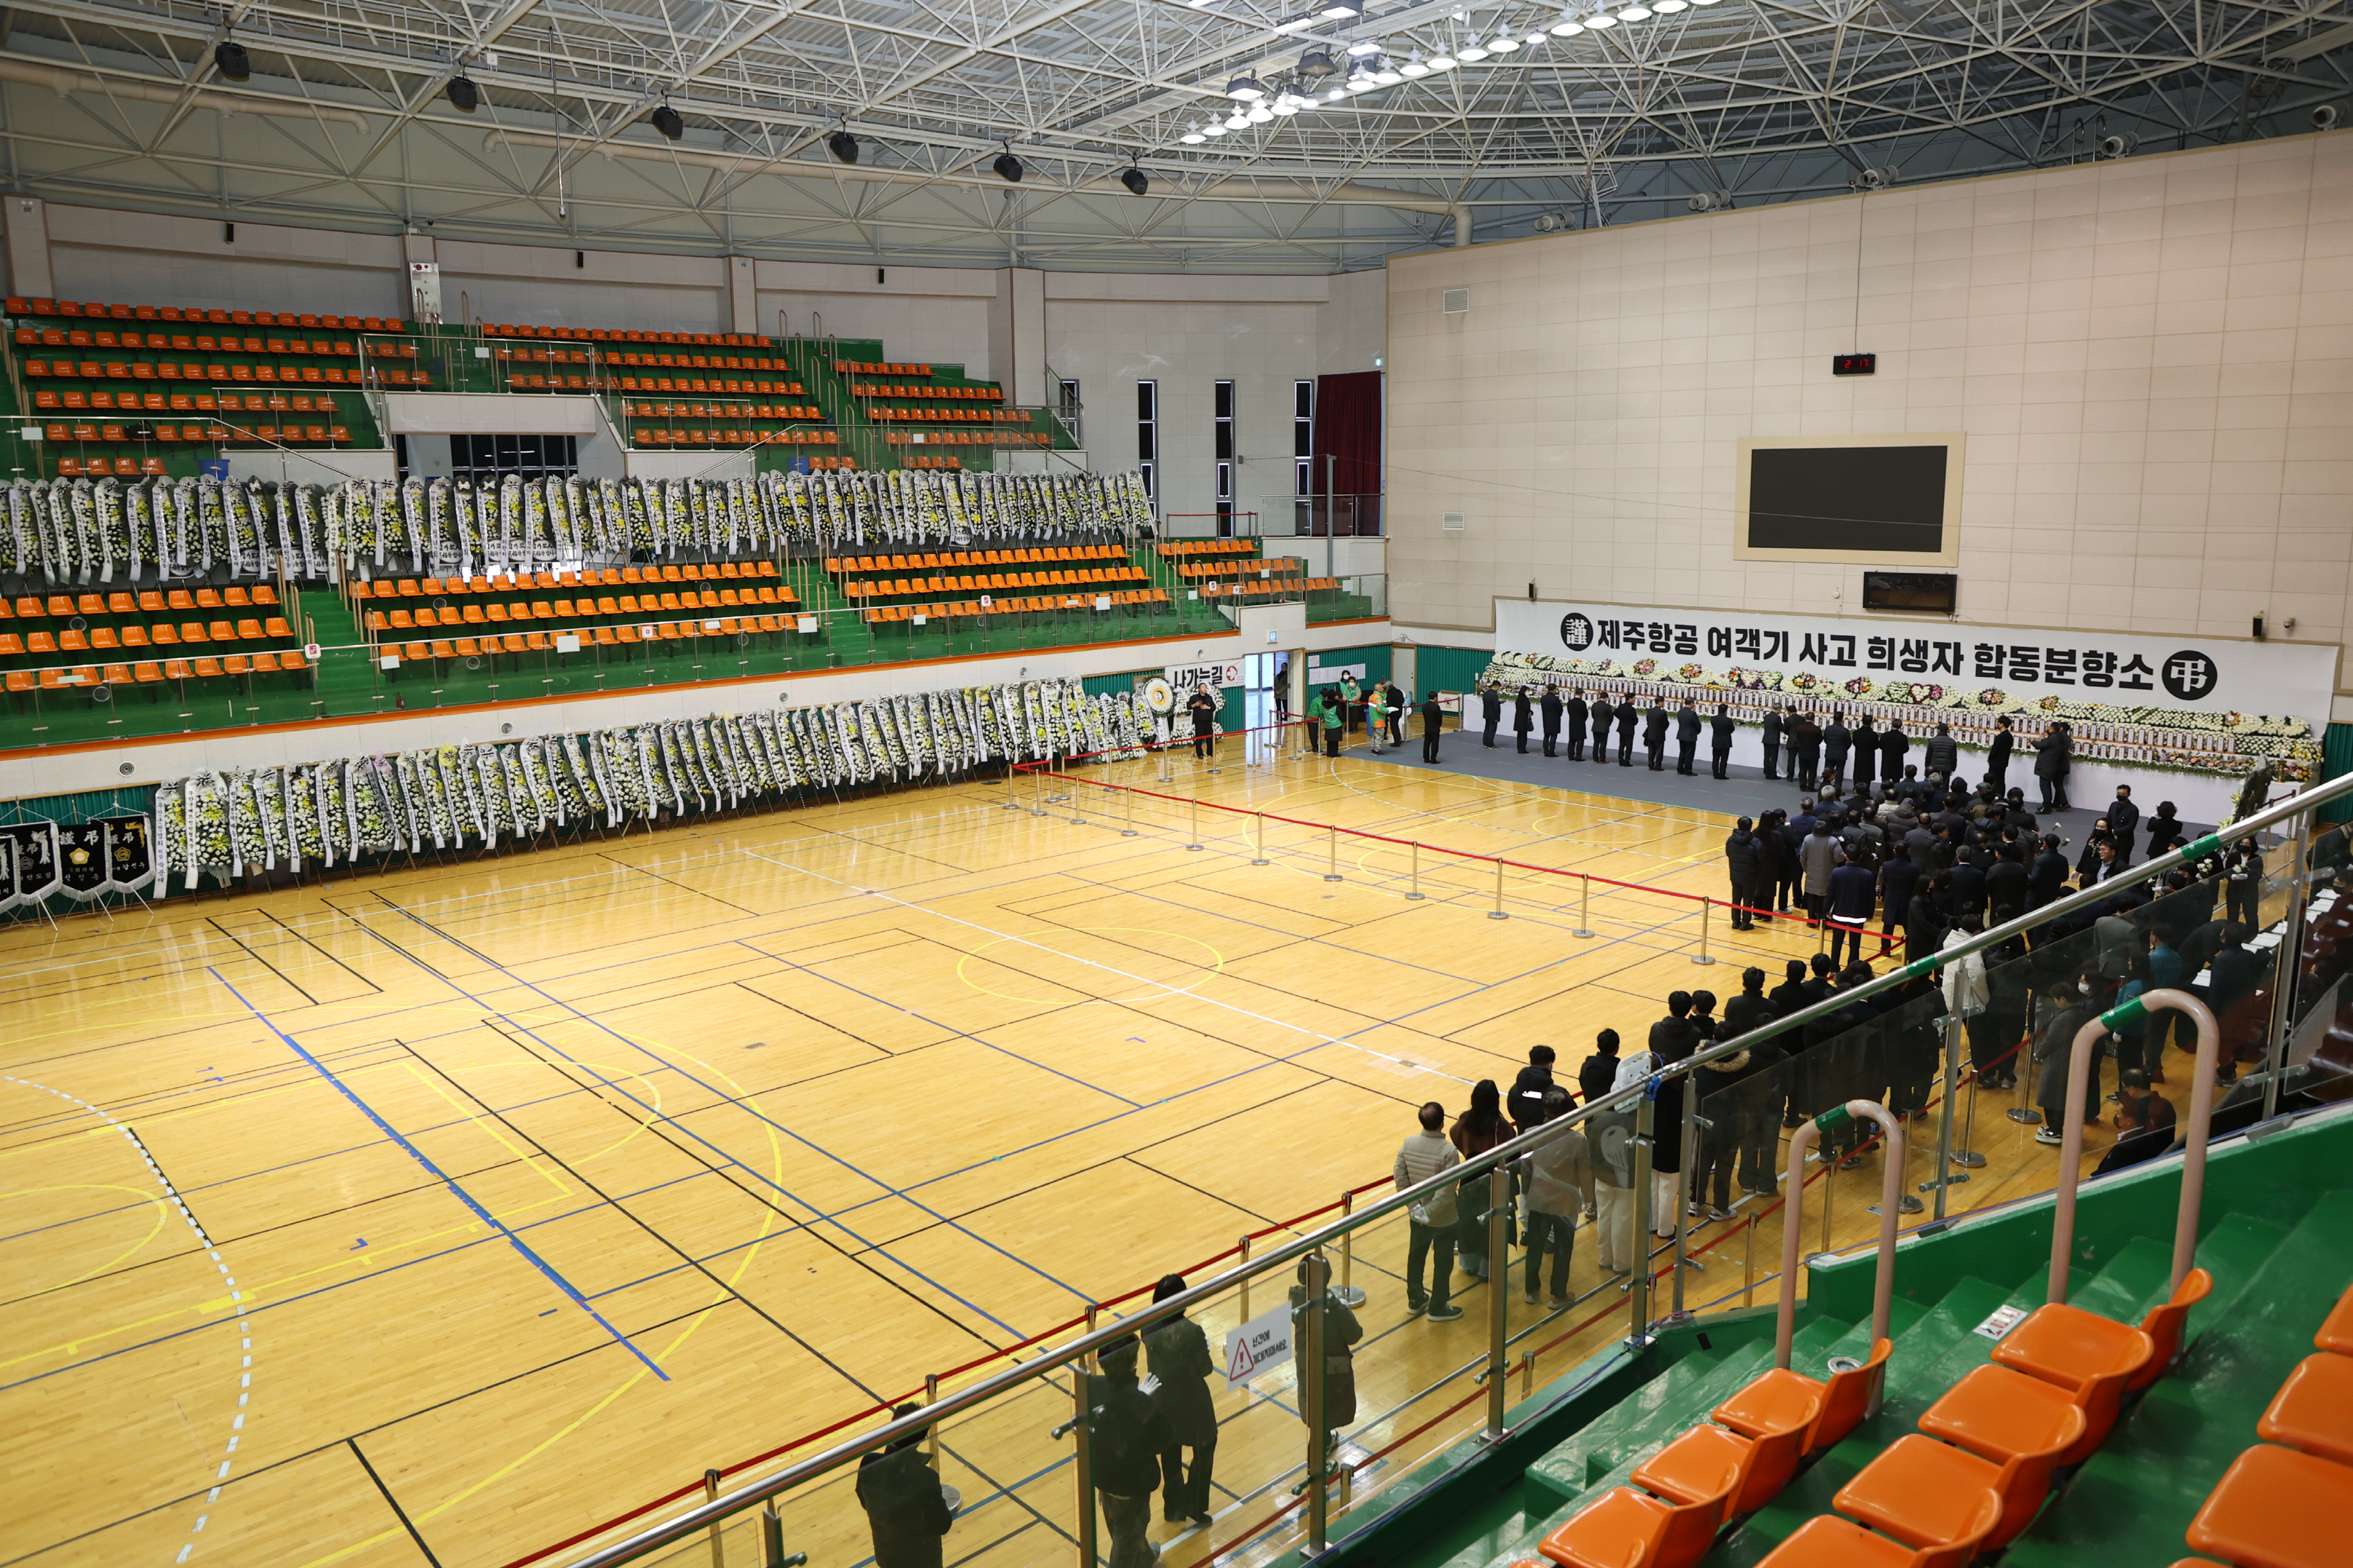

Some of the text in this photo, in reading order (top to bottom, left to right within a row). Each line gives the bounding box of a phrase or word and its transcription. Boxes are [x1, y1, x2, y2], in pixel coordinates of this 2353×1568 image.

[1598, 619, 2154, 691] 제주항공 여객기 사고 희생자 합동분향소
[1175, 665, 1222, 689] 나가는길
[1252, 1329, 1270, 1348] 난간에
